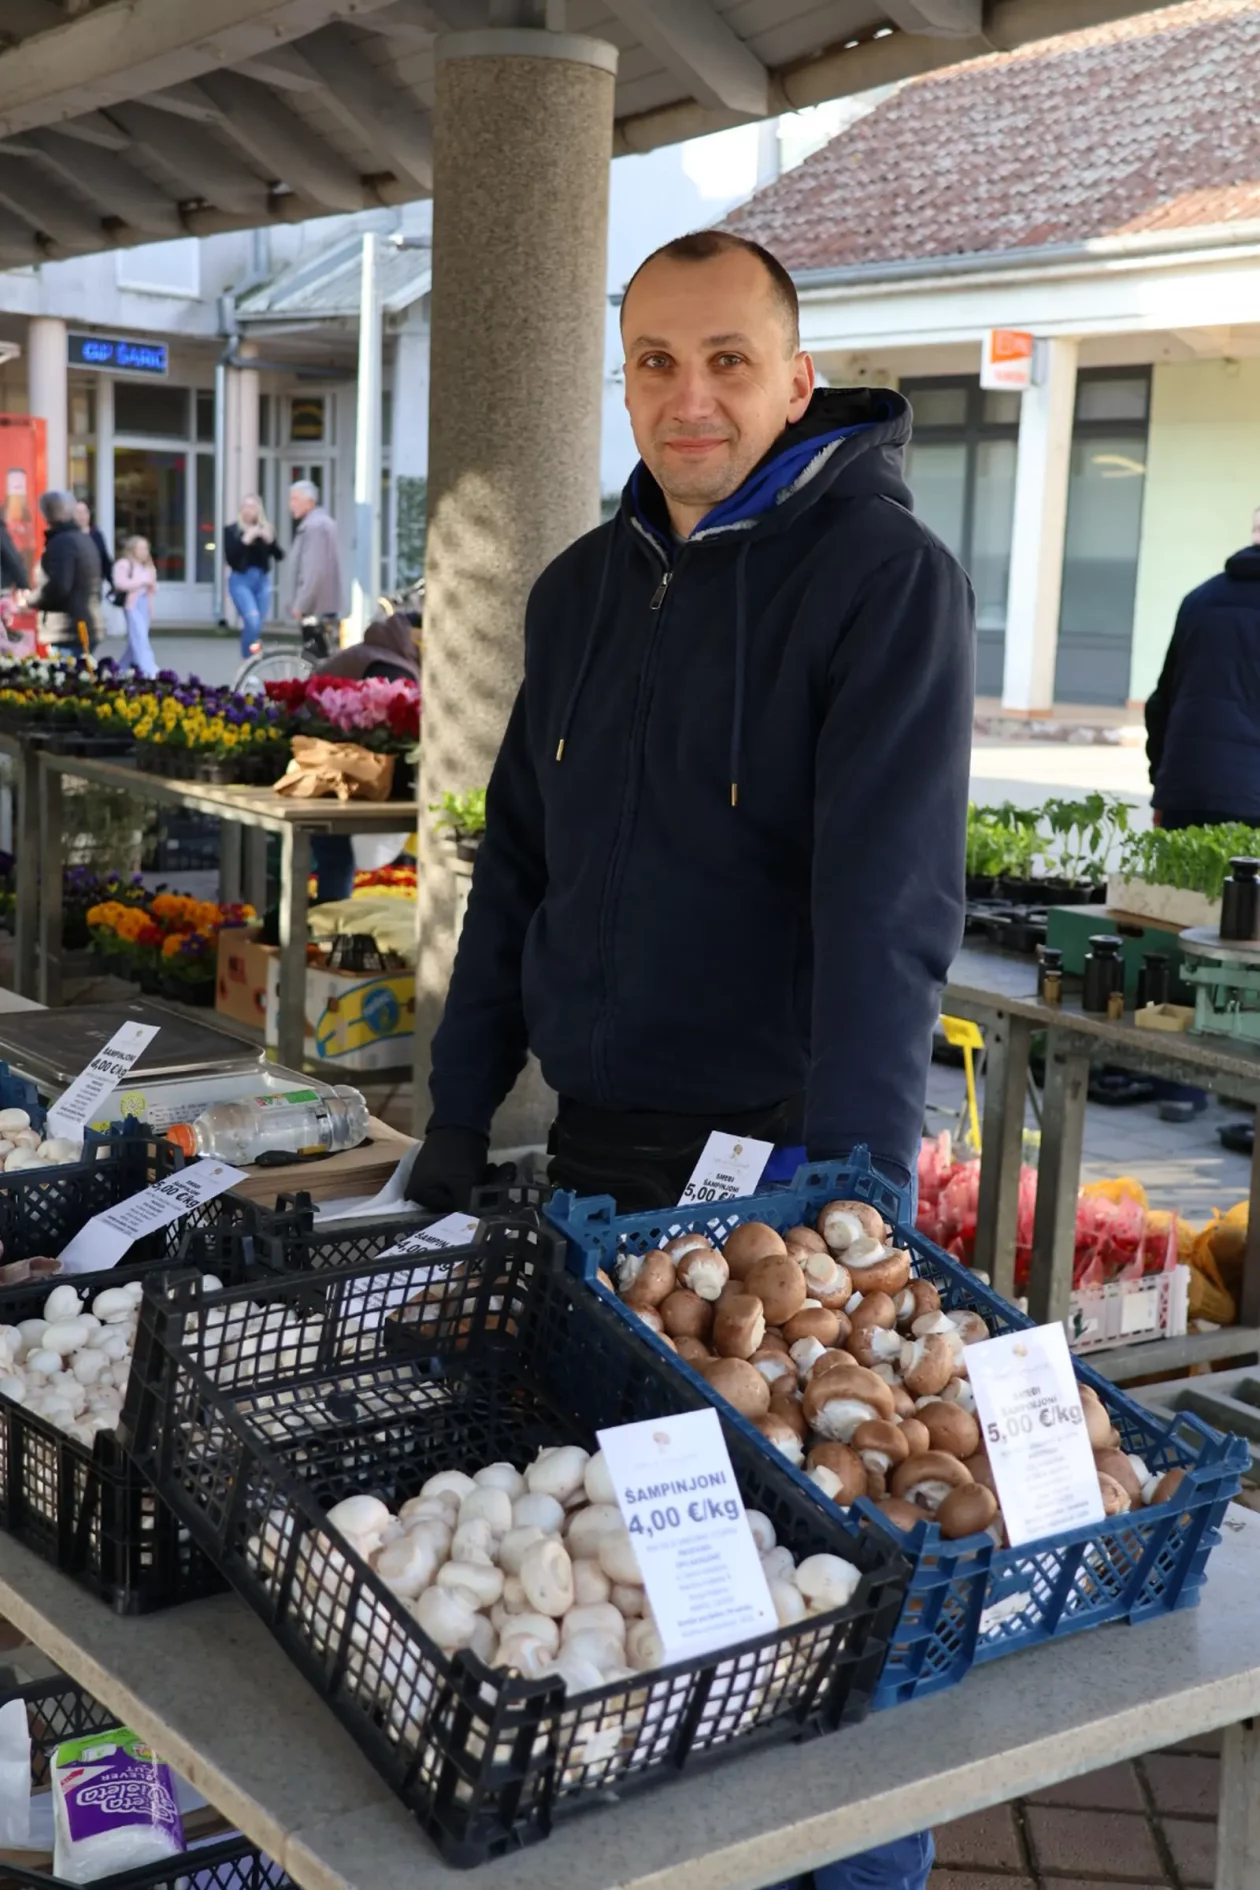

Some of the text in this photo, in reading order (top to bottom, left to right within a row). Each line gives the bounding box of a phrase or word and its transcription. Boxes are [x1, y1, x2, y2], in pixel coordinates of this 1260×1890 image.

[684, 1183, 716, 1202] 5,00
[987, 1405, 1083, 1444] 5,00 €/kg
[625, 1471, 727, 1504] ŠAMPINJONI
[628, 1496, 740, 1538] 4,00 €/kg
